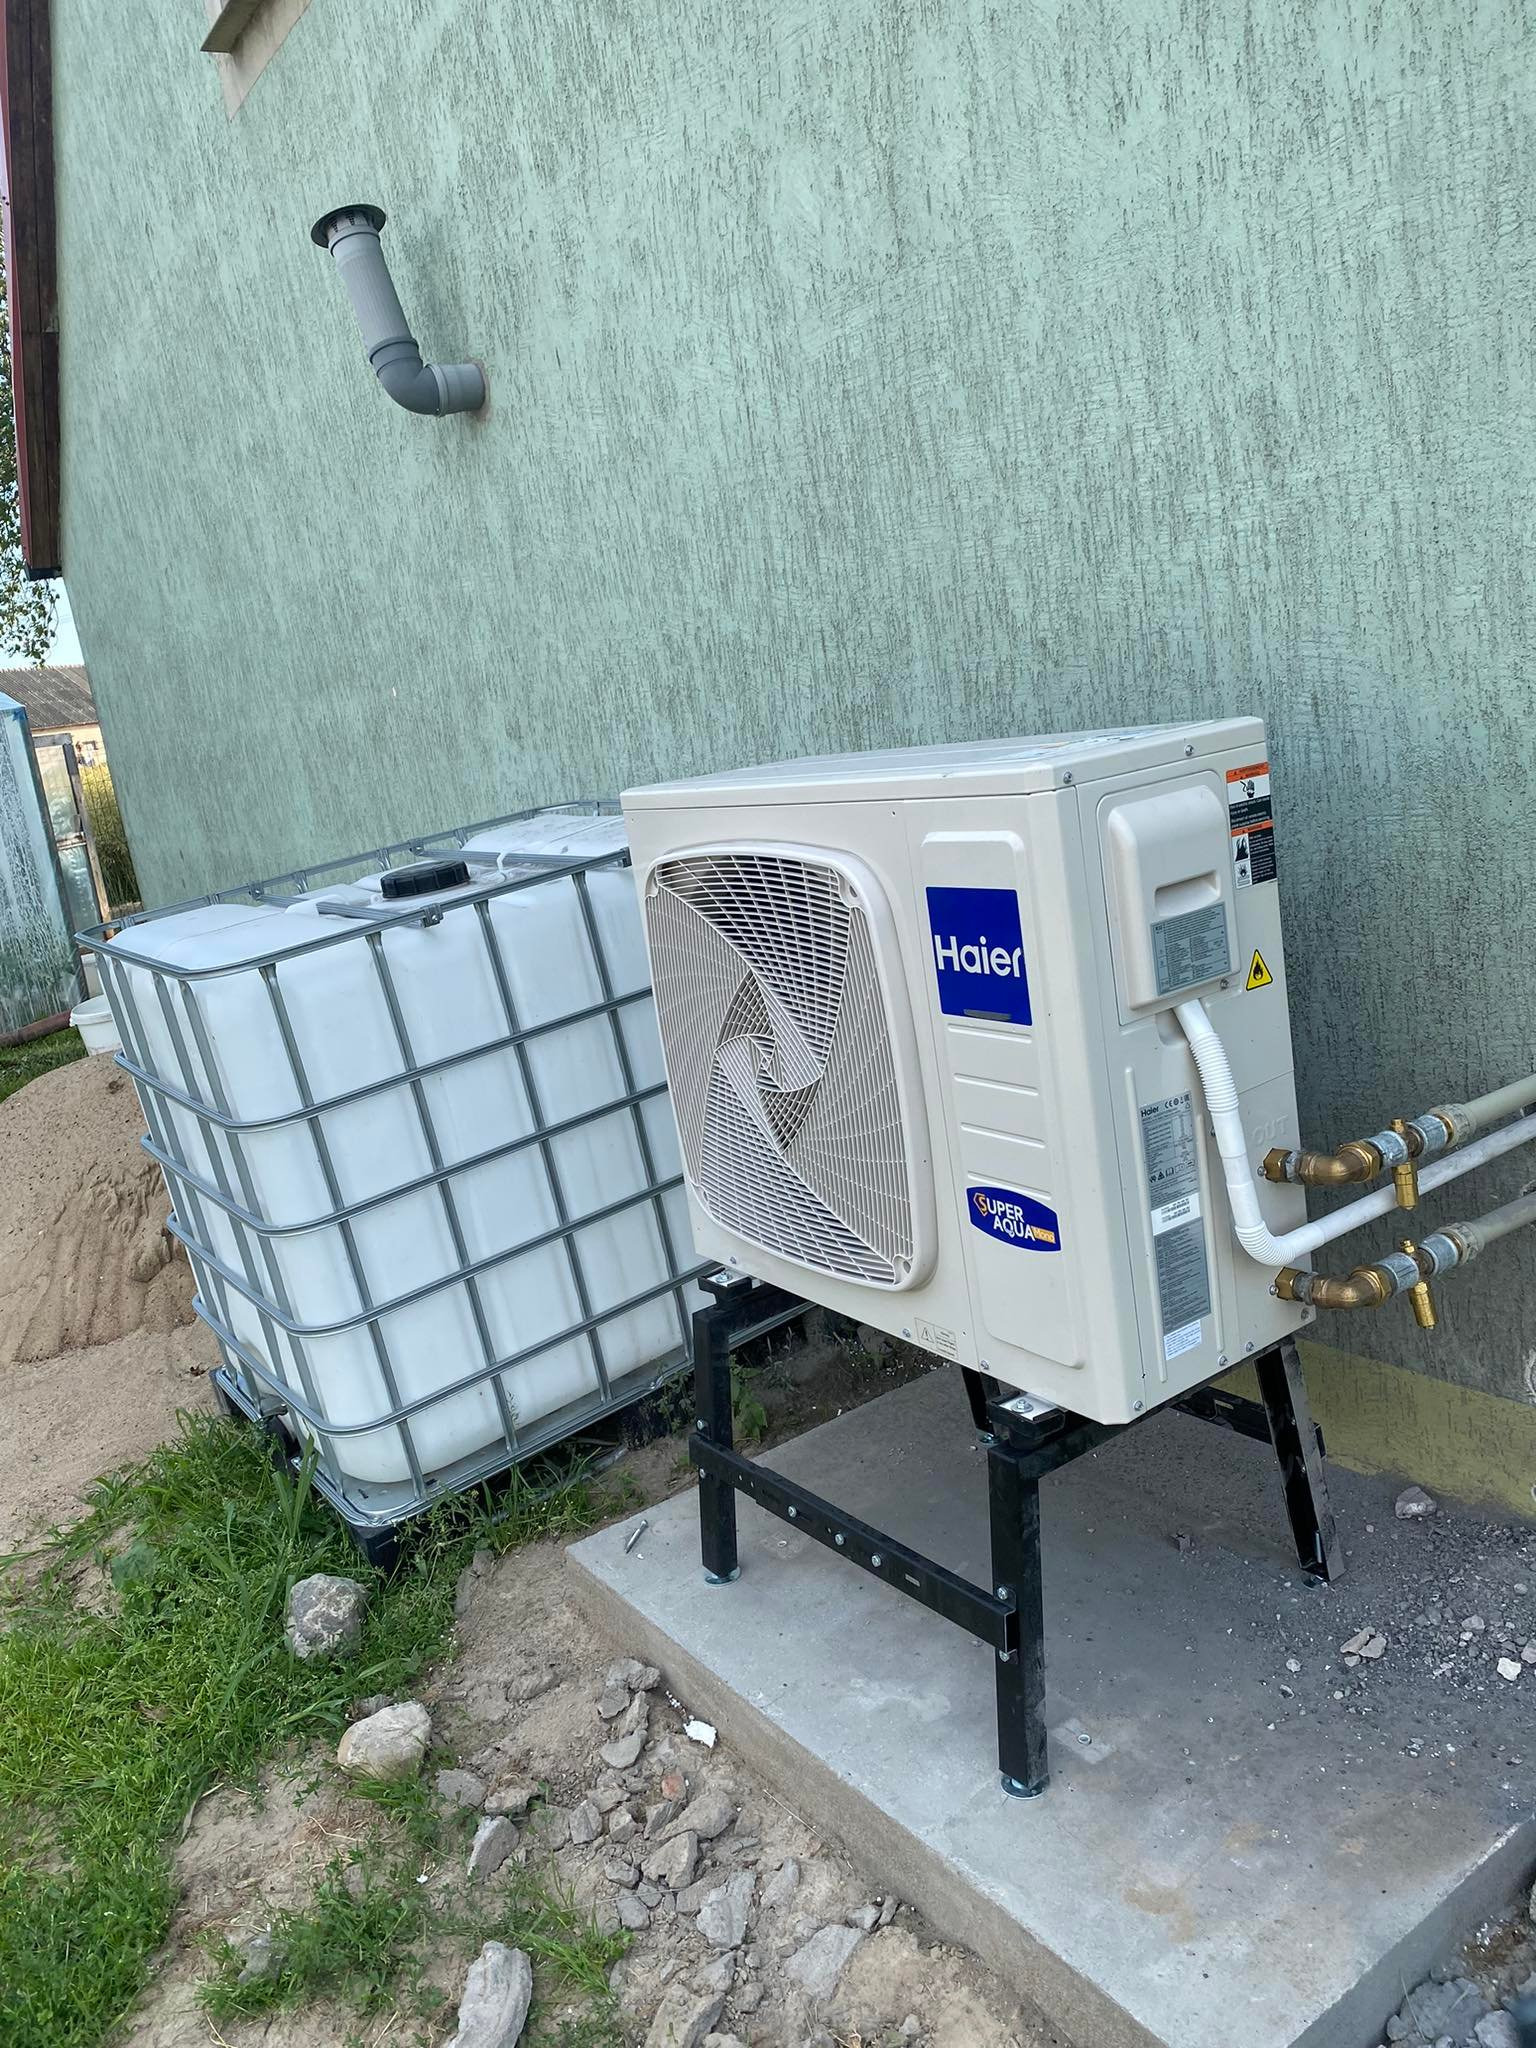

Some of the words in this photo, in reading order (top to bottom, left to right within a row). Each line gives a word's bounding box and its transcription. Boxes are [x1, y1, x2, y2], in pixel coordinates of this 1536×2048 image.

[934, 934, 1022, 978] Haier
[1140, 1105, 1159, 1117] Haier
[1252, 1114, 1289, 1146] OUT
[977, 1194, 1024, 1223] SUPER
[993, 1214, 1036, 1241] AQUA
